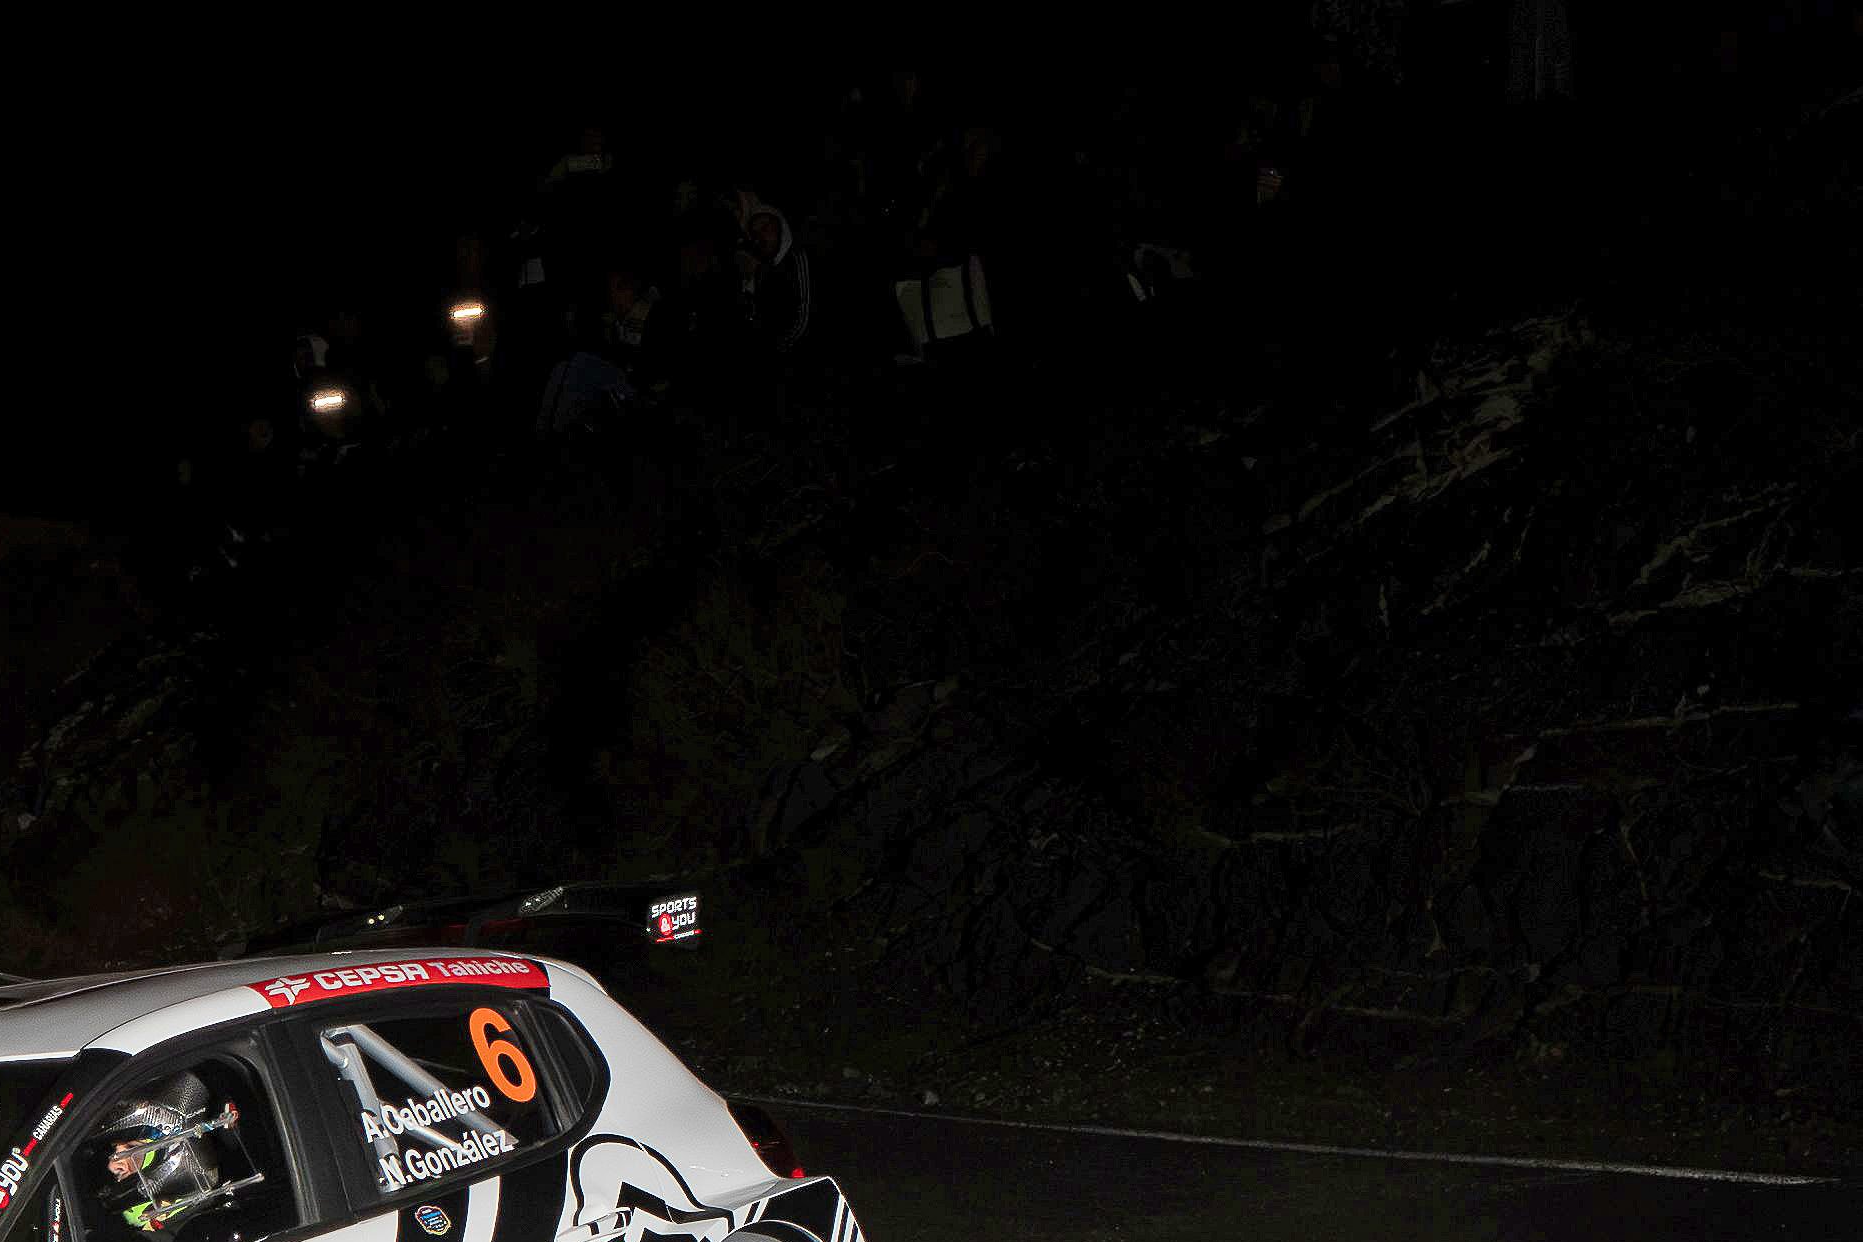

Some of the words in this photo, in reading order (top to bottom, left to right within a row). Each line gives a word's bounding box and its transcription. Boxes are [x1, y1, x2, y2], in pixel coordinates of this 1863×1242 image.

[652, 896, 697, 918] SPORTS
[313, 963, 429, 990] CEPSA
[427, 959, 531, 977] Tahiche
[469, 1008, 536, 1102] 6
[33, 1105, 63, 1141] CANARIAS
